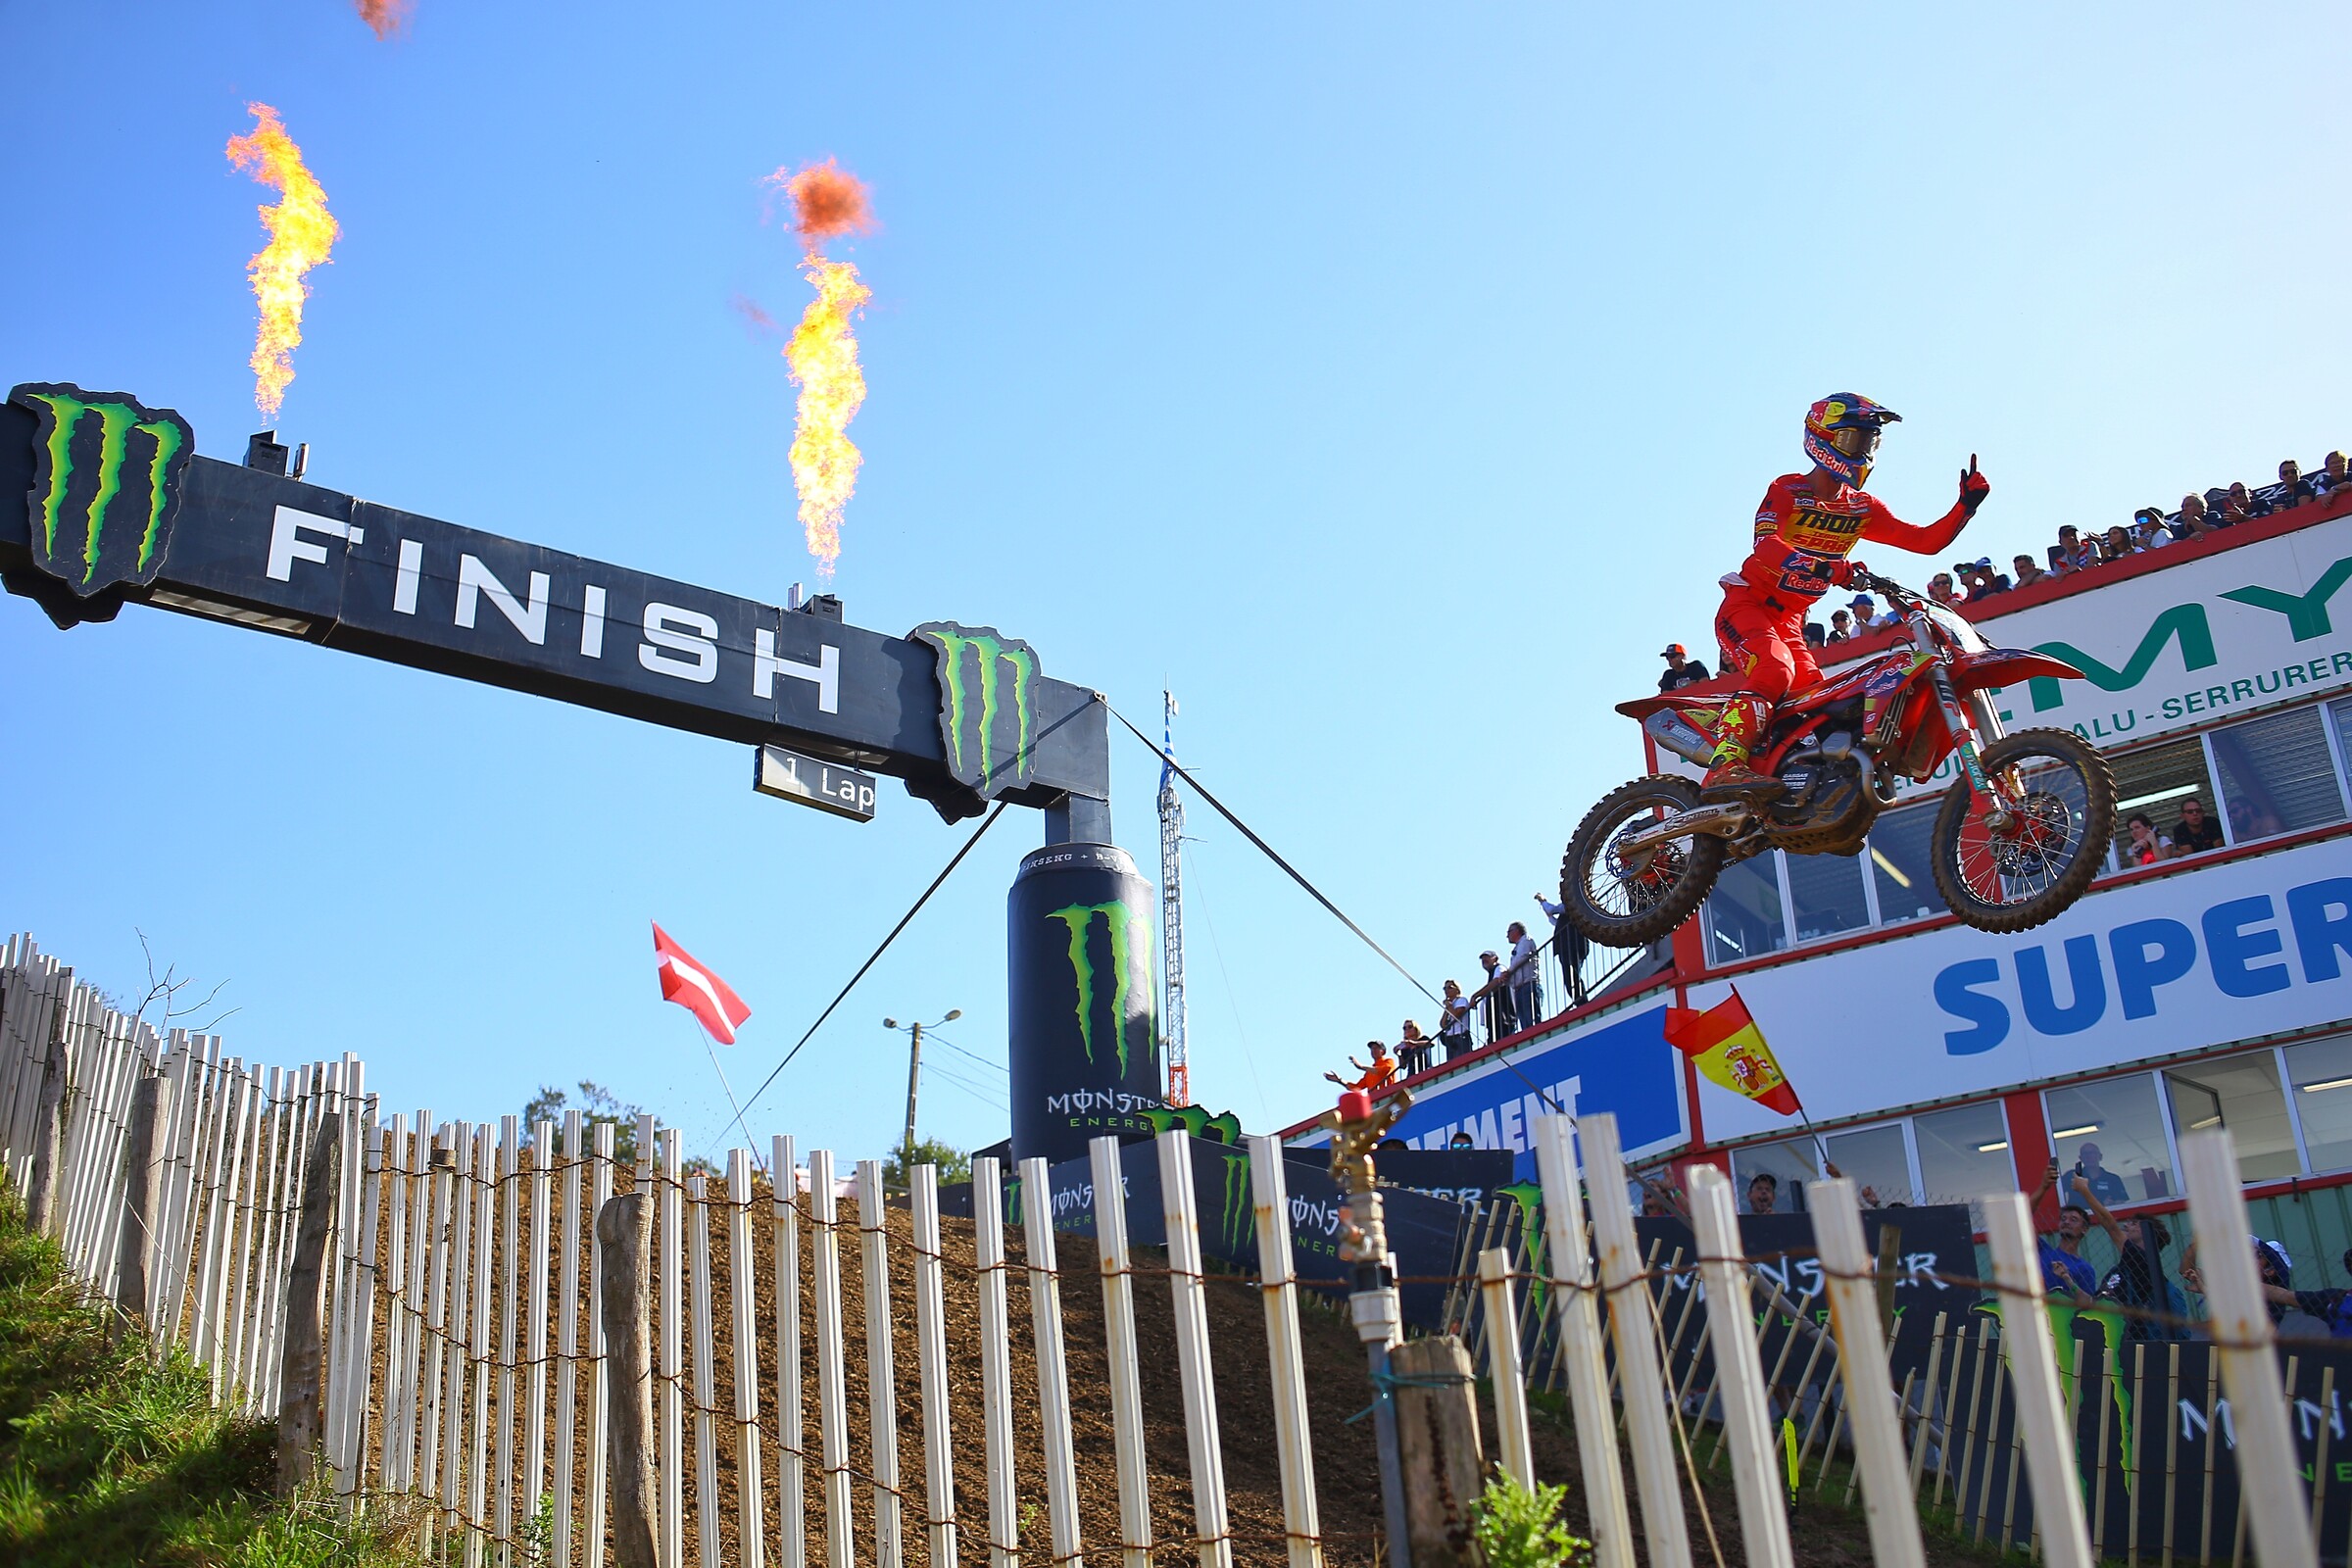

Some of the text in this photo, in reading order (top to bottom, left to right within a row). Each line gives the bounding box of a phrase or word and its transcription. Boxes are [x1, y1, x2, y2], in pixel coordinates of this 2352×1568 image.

[1795, 509, 1862, 533] THOR
[266, 504, 840, 714] FINISH
[786, 757, 875, 811] 1 Lap
[1934, 876, 2352, 1055] SUPER
[1069, 1117, 1149, 1130] ENERG
[1054, 1214, 1092, 1232] ENER
